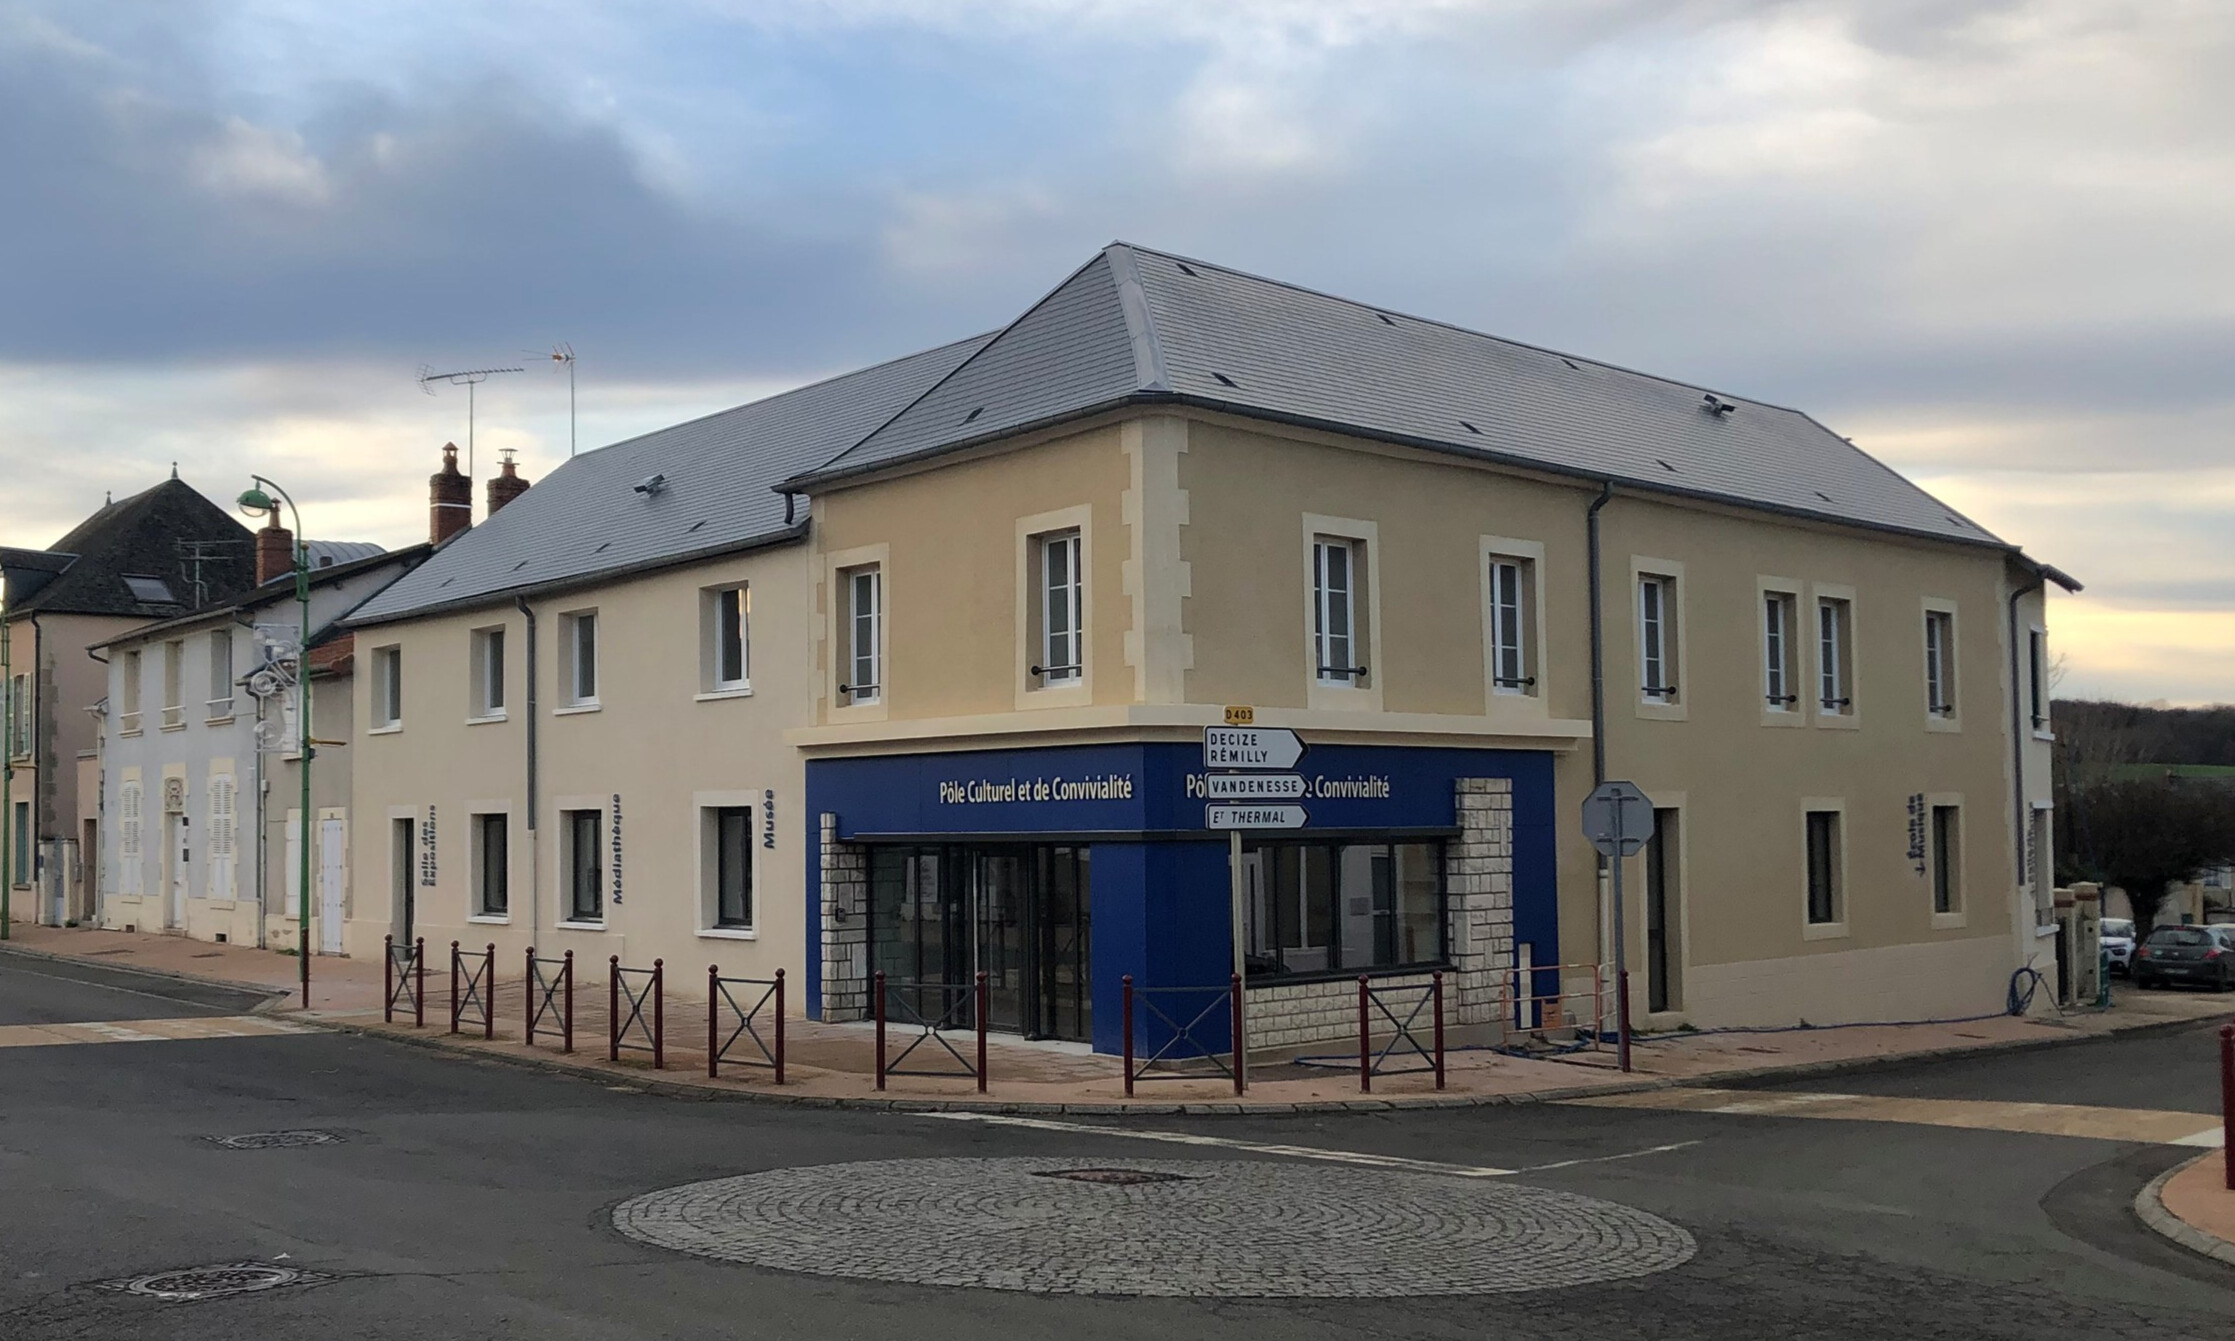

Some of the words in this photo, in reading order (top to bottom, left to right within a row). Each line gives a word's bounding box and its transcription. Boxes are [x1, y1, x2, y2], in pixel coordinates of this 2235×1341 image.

[1226, 710, 1232, 720] D
[1234, 709, 1253, 720] 403
[1210, 733, 1257, 746] DECIZE
[1210, 748, 1268, 763] RÉMILLY
[939, 780, 965, 804] Pôle
[967, 777, 1016, 803] Culturel
[1018, 780, 1031, 802] et
[1033, 777, 1050, 801] de
[1052, 773, 1132, 801] Convivialité
[1186, 773, 1205, 799] Pô
[1315, 774, 1390, 799] Convivialité
[1212, 780, 1299, 793] VANDENESSE
[763, 789, 775, 849] Musée
[1232, 811, 1286, 824] THERMAL
[1916, 793, 1926, 858] Musique
[421, 821, 429, 846] des
[429, 804, 438, 887] Expositions
[612, 793, 623, 905] Médiathèque
[421, 852, 429, 887] Salle
